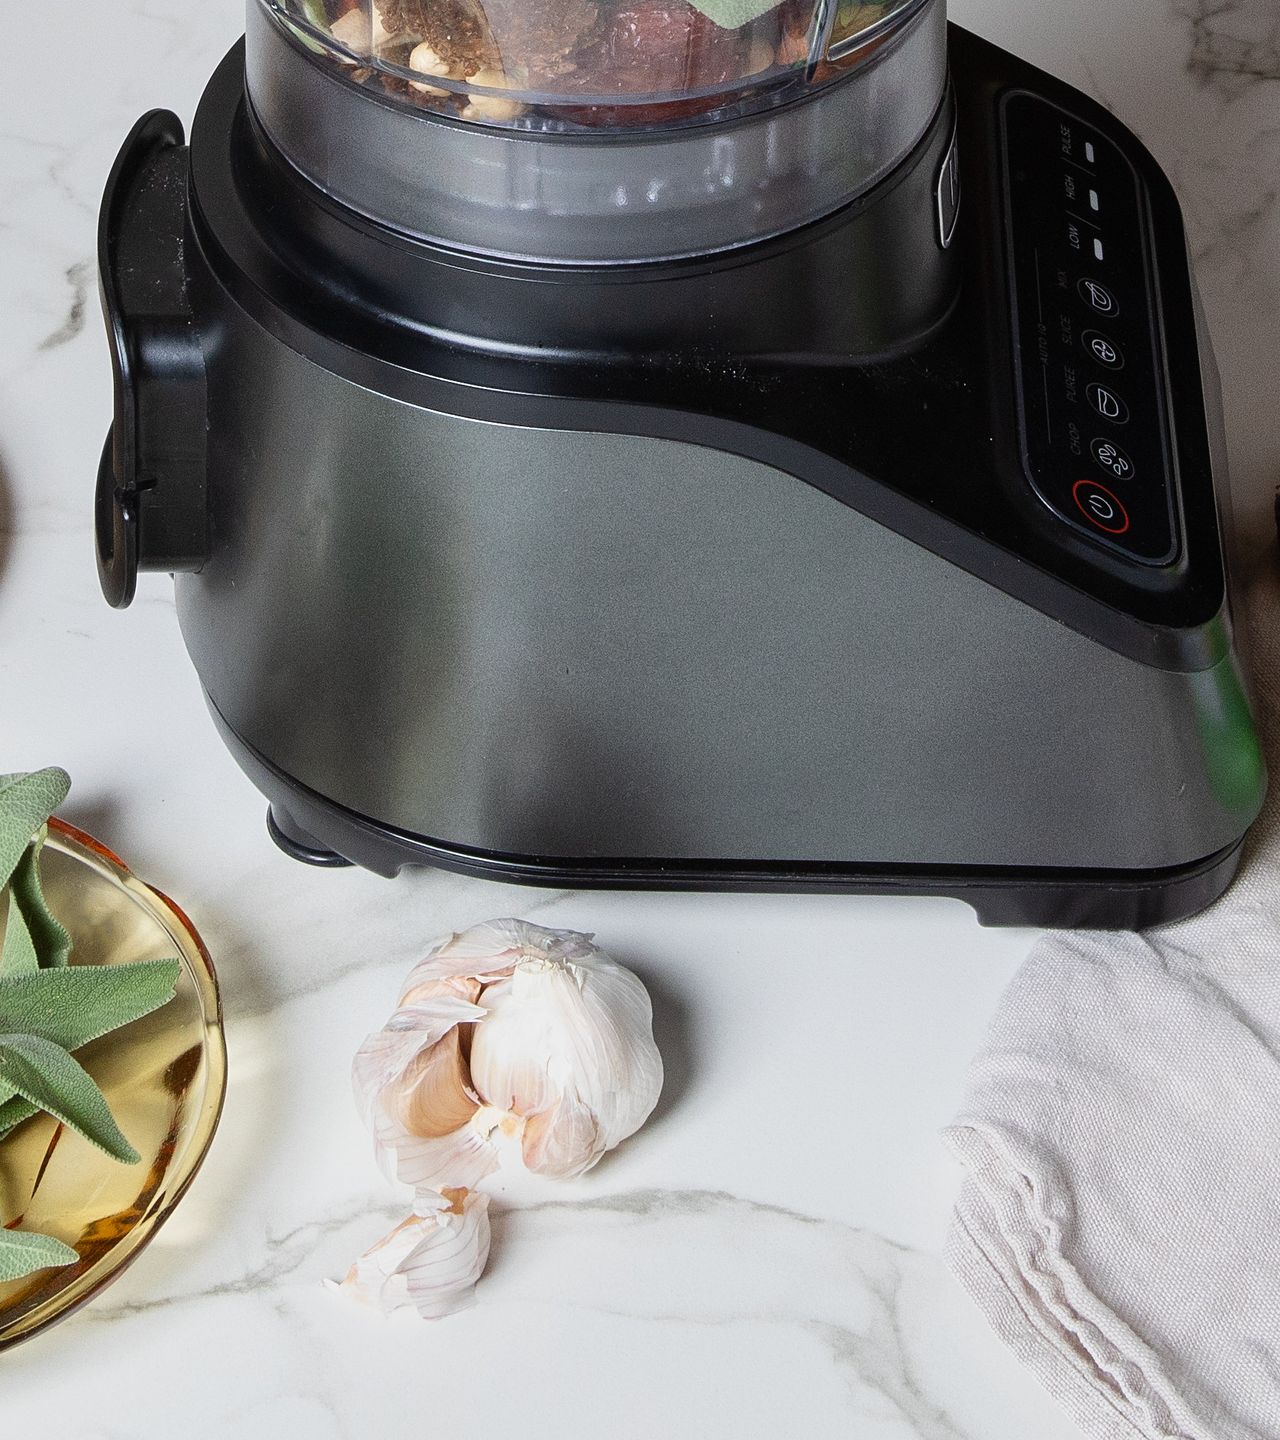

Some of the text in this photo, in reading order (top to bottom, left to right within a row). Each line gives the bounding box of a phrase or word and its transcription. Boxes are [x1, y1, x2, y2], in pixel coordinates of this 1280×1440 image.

[1060, 124, 1073, 155] PULSE
[1064, 175, 1076, 200] HIGH
[1069, 224, 1081, 250] LOW
[1065, 366, 1078, 402] PUREE
[1069, 422, 1082, 456] CHOP
